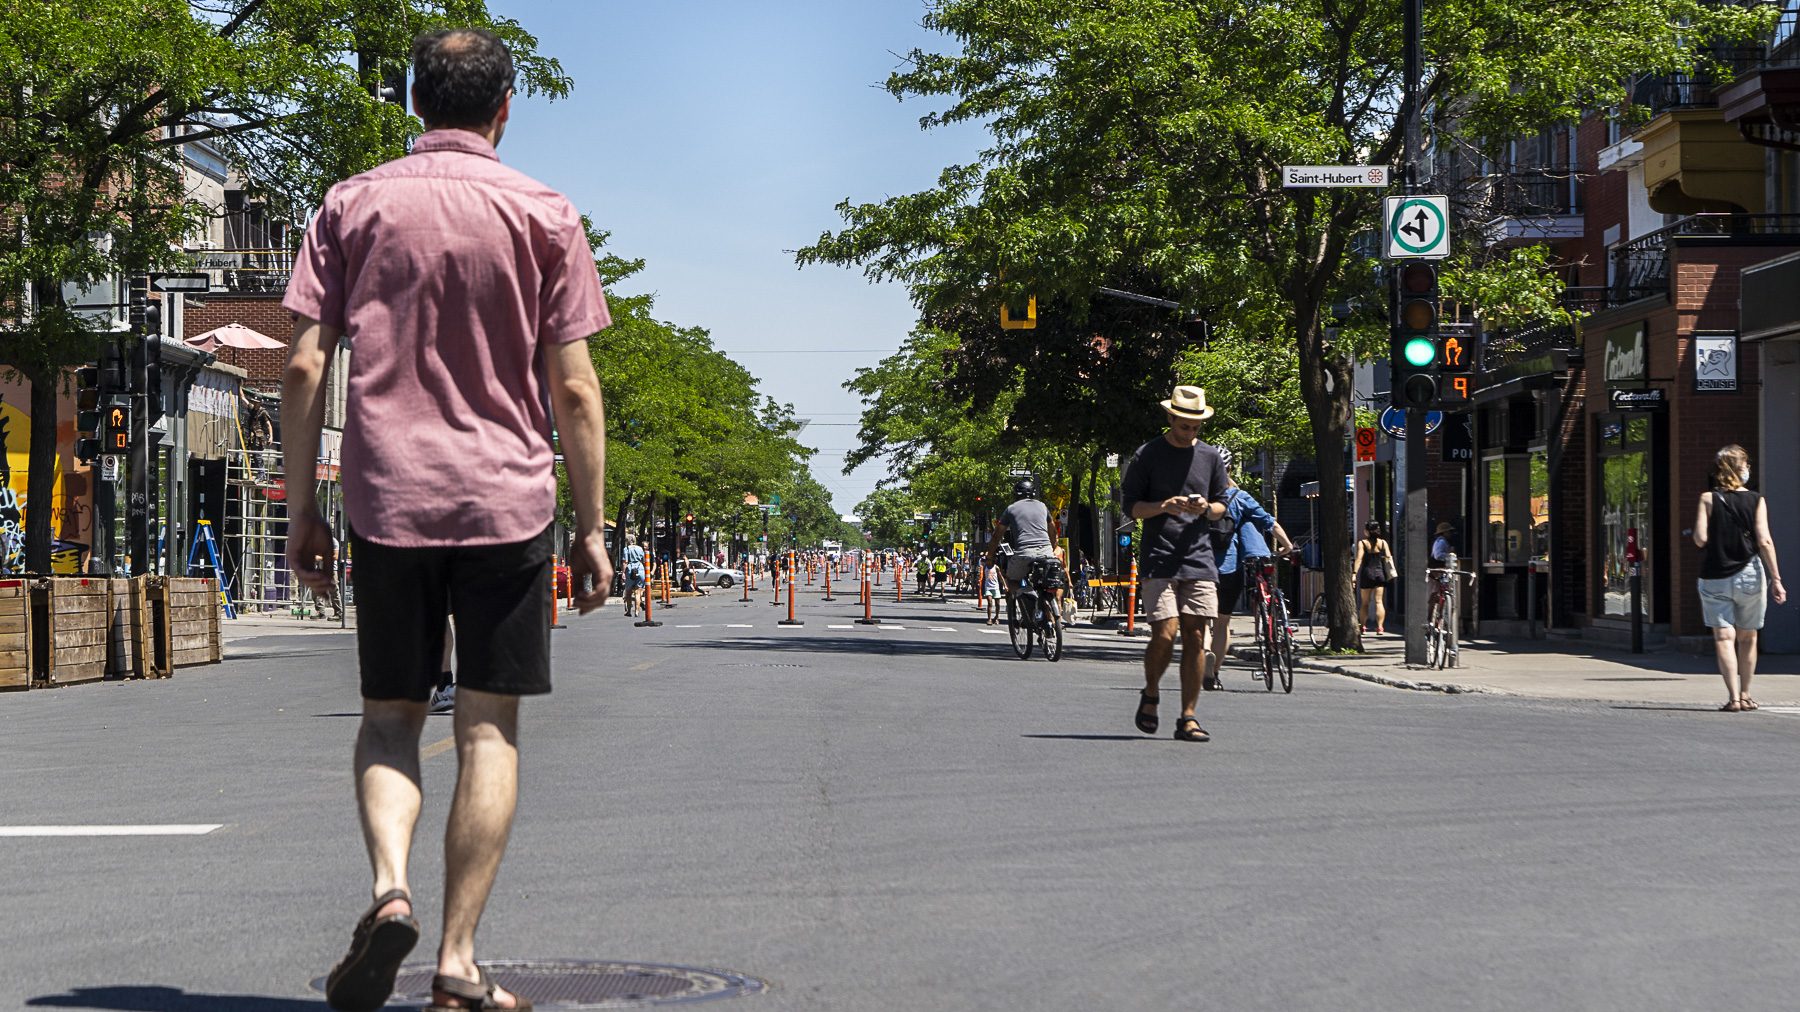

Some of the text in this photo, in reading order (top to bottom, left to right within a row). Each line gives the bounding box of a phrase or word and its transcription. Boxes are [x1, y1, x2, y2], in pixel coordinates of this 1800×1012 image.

[1289, 173, 1363, 184] Saint-Hubert
[1453, 377, 1467, 399] 9
[1698, 379, 1736, 389] DENTISTE
